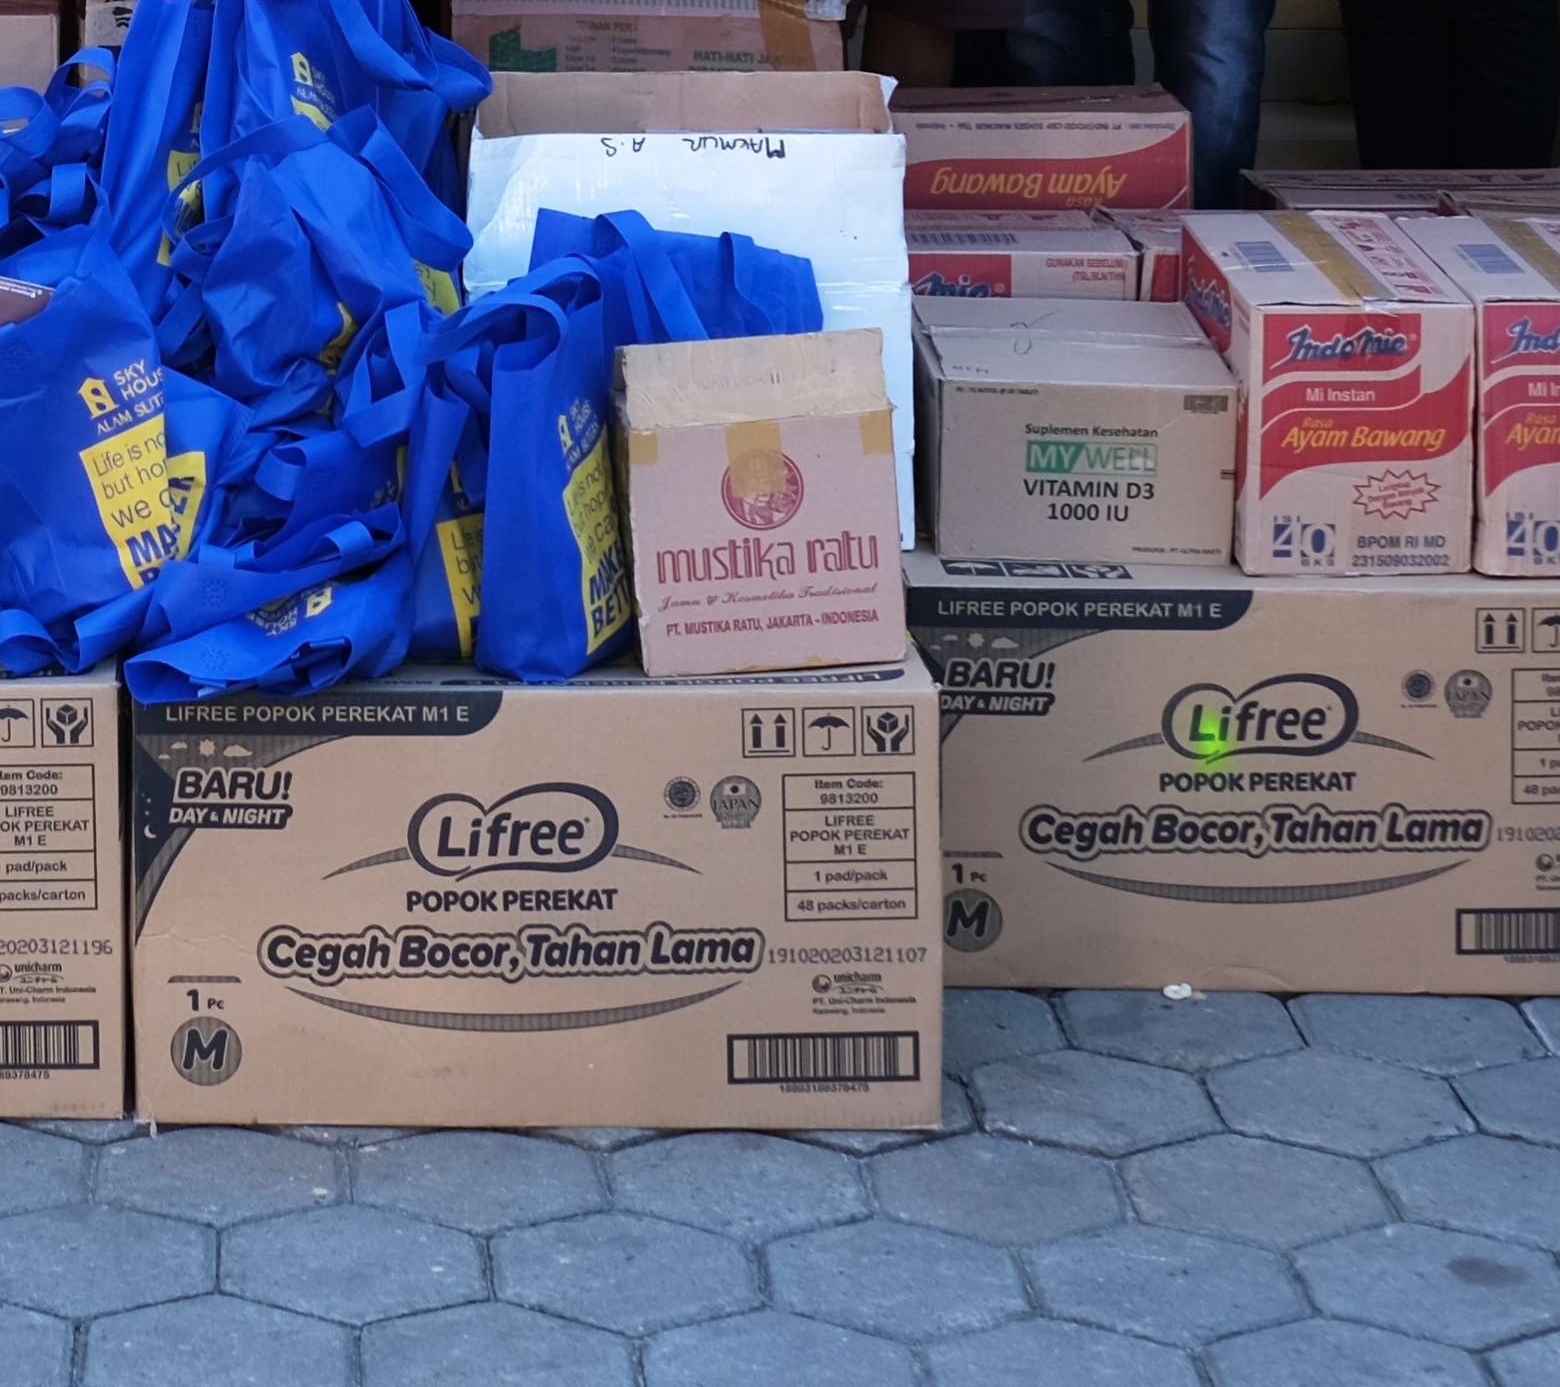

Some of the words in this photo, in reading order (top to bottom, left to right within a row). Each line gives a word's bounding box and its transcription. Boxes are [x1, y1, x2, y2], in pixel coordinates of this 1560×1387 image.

[931, 167, 1044, 198] Bawang
[1048, 166, 1127, 198] Ayam
[114, 359, 146, 386] SKY
[1306, 388, 1323, 401] Mi
[1328, 388, 1375, 401] Instan
[1528, 383, 1546, 396] Mi
[1025, 424, 1088, 436] Suplemen
[1093, 426, 1158, 437] Kesehatan
[1282, 427, 1347, 453] Ayam
[1351, 427, 1445, 452] Bawang
[1024, 479, 1118, 497] VITAMIN
[1127, 483, 1154, 499] D3
[1048, 503, 1099, 521] 1000
[1107, 506, 1128, 521] IU
[1357, 536, 1400, 548] BPOM
[1405, 536, 1419, 548] RI
[1424, 536, 1445, 548] MD
[657, 537, 795, 584] mustika
[807, 531, 878, 573] ratu
[939, 601, 1004, 615] LIFREE
[1010, 602, 1079, 616] POPOK
[1084, 603, 1172, 617] PEREKAT
[1178, 604, 1202, 618] M1
[1210, 604, 1221, 618] E
[667, 623, 680, 637] PT.
[685, 620, 730, 635] MUSTIKA
[733, 619, 763, 632] RATU,
[766, 615, 813, 628] JAKARTA
[821, 609, 879, 625] INDONESIA
[947, 661, 1055, 689] BARU!
[166, 706, 236, 721] LIFREE
[243, 707, 315, 722] POPOK
[322, 707, 417, 722] PEREKAT
[423, 707, 449, 721] M1
[457, 707, 468, 721] E
[1190, 702, 1326, 742] Lifree
[178, 771, 292, 800] BARU!
[1160, 773, 1244, 792] POPOK
[1249, 772, 1356, 792] PEREKAT
[5, 806, 54, 818] LIFREE
[25, 820, 89, 831] PEREKAT
[437, 813, 584, 857] Lifree
[1028, 813, 1143, 848] Cegah
[1152, 814, 1265, 849] Bocor,
[1270, 814, 1375, 844] Tahan
[1386, 812, 1483, 843] Lama
[15, 835, 33, 846] M1
[38, 835, 47, 845] E
[6, 861, 67, 874] pad/pack
[406, 890, 497, 912] POPOK
[503, 889, 618, 910] PEREKAT
[267, 936, 390, 975] Cegah
[399, 936, 518, 973] Bocor,
[527, 935, 639, 967] Tahan
[651, 932, 754, 964] Lama
